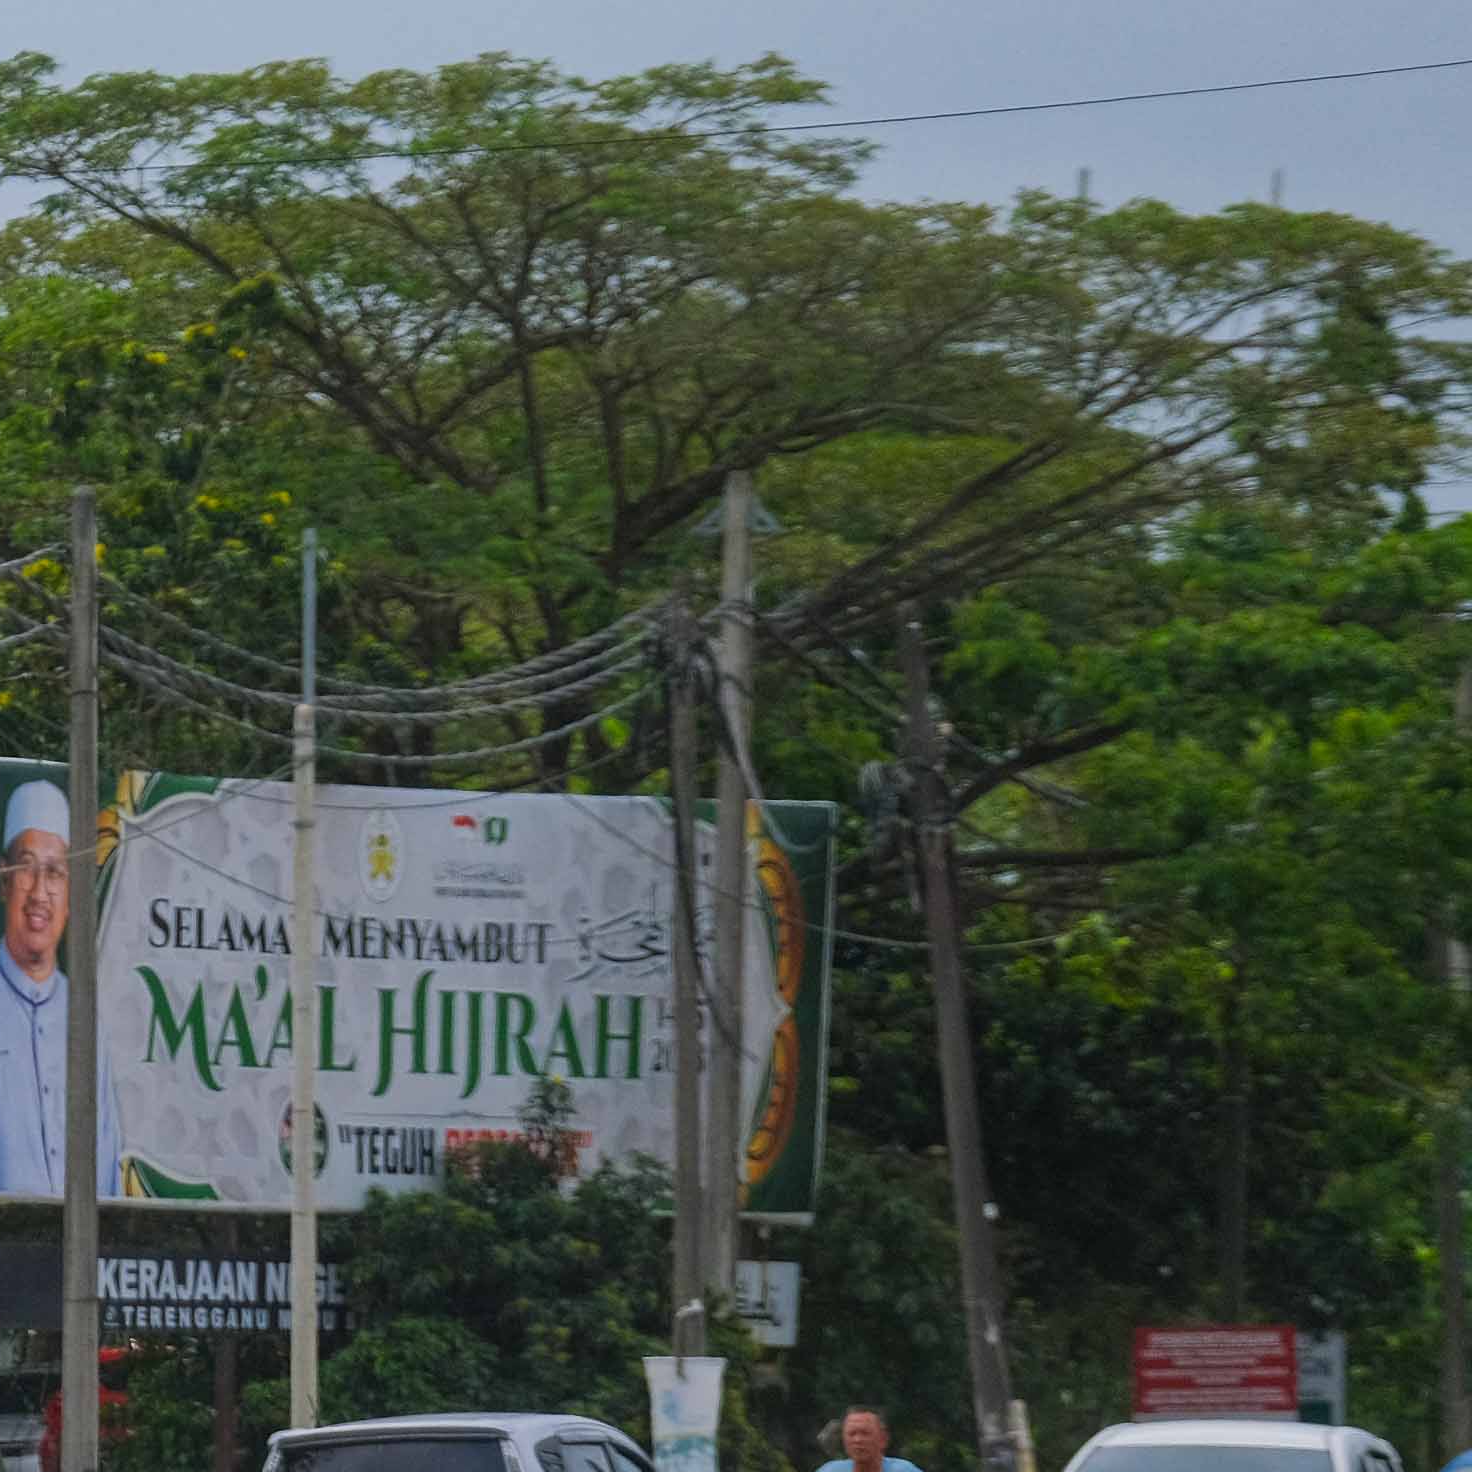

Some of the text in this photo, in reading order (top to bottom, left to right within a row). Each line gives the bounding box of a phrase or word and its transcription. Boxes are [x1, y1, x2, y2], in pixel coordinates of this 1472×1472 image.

[148, 897, 296, 955] SELAMA
[321, 912, 553, 964] MENYAMBUT
[368, 968, 644, 1098] HIJRAH
[97, 1257, 259, 1301] KERAJAAN
[121, 1306, 270, 1329] TERENGGANU
